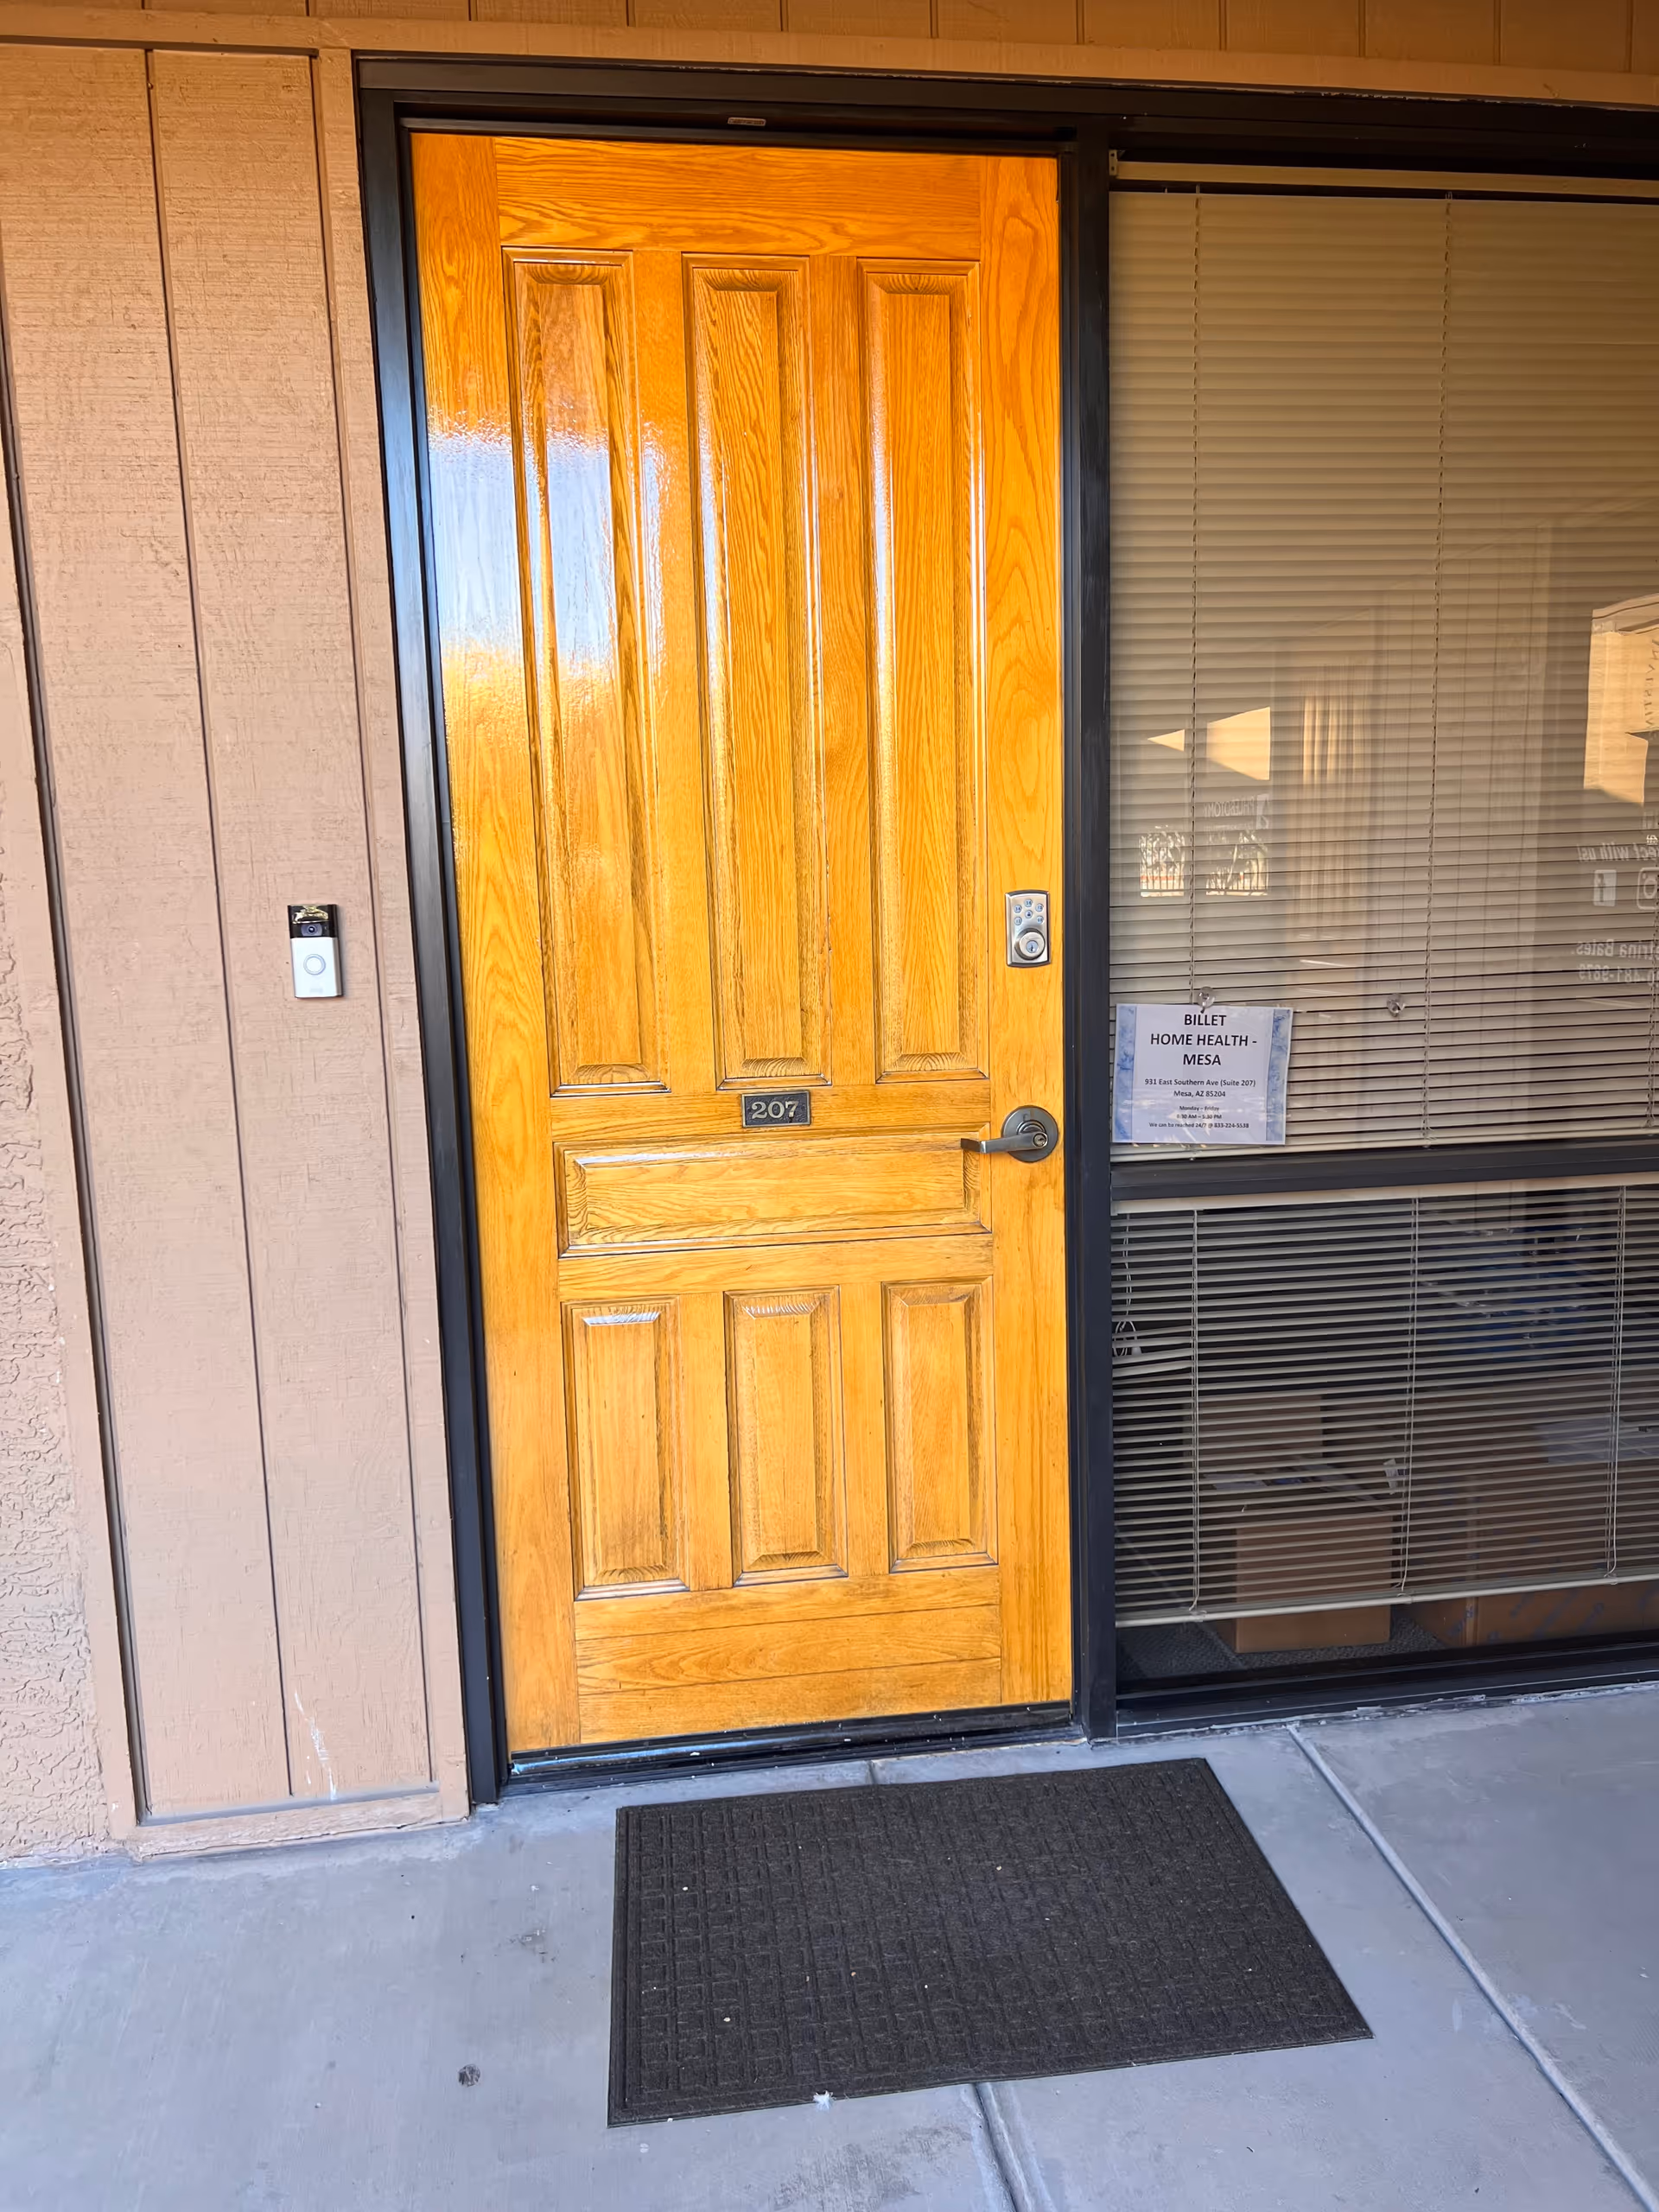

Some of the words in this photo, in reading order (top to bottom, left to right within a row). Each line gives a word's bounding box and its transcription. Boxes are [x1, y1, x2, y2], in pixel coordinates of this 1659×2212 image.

[1184, 1014, 1227, 1026] BILLET
[1150, 1033, 1193, 1046] HOME
[1197, 1034, 1249, 1046] HEALTH
[1183, 1054, 1221, 1065] MESA
[751, 1100, 799, 1119] 207
